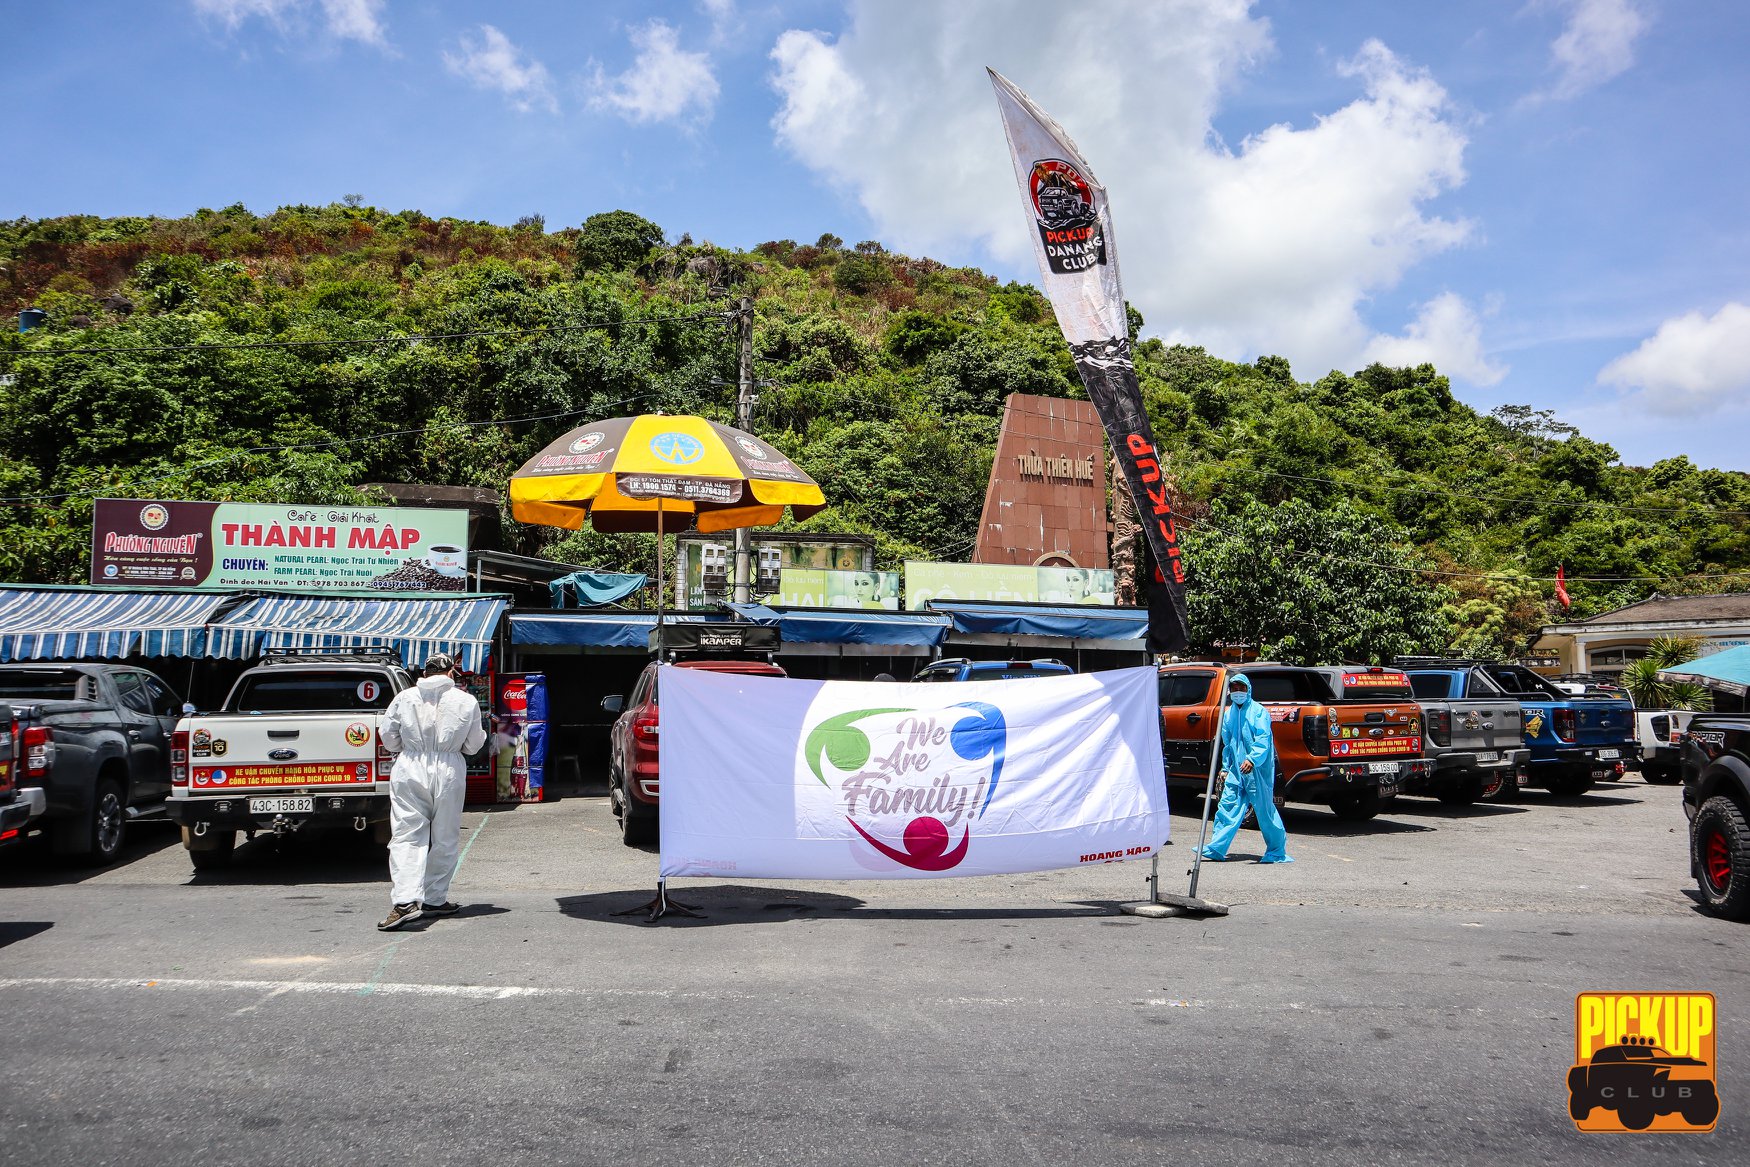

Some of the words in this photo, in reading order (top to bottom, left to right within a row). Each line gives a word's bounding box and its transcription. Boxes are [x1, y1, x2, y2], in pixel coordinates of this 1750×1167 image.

[1046, 227, 1095, 243] PICKUP
[1047, 236, 1102, 257] DANANG
[1062, 253, 1096, 270] CLUB
[1045, 453, 1073, 478] THIÊN
[1074, 452, 1094, 480] HUẾ
[221, 520, 337, 548] THÀNH
[347, 523, 420, 556] MẬP
[222, 557, 269, 571] CHUYÊN:
[274, 555, 304, 564] NATURAL
[351, 557, 366, 565] Trai
[274, 567, 293, 576] FARM
[295, 567, 318, 576] PEARL:
[339, 568, 355, 577] Trai
[363, 682, 374, 700] 6
[896, 717, 947, 750] We
[873, 741, 931, 776] Are
[303, 765, 317, 774] HÓA
[228, 776, 246, 785] CÔNG
[247, 776, 260, 785] TÁC
[261, 775, 283, 784] PHÒNG
[306, 774, 322, 783] DỊCH
[323, 773, 343, 782] COVID
[343, 774, 351, 782] 19
[251, 801, 311, 812] 43C-158.82
[841, 771, 986, 827] Family!
[1080, 850, 1123, 862] HOANG
